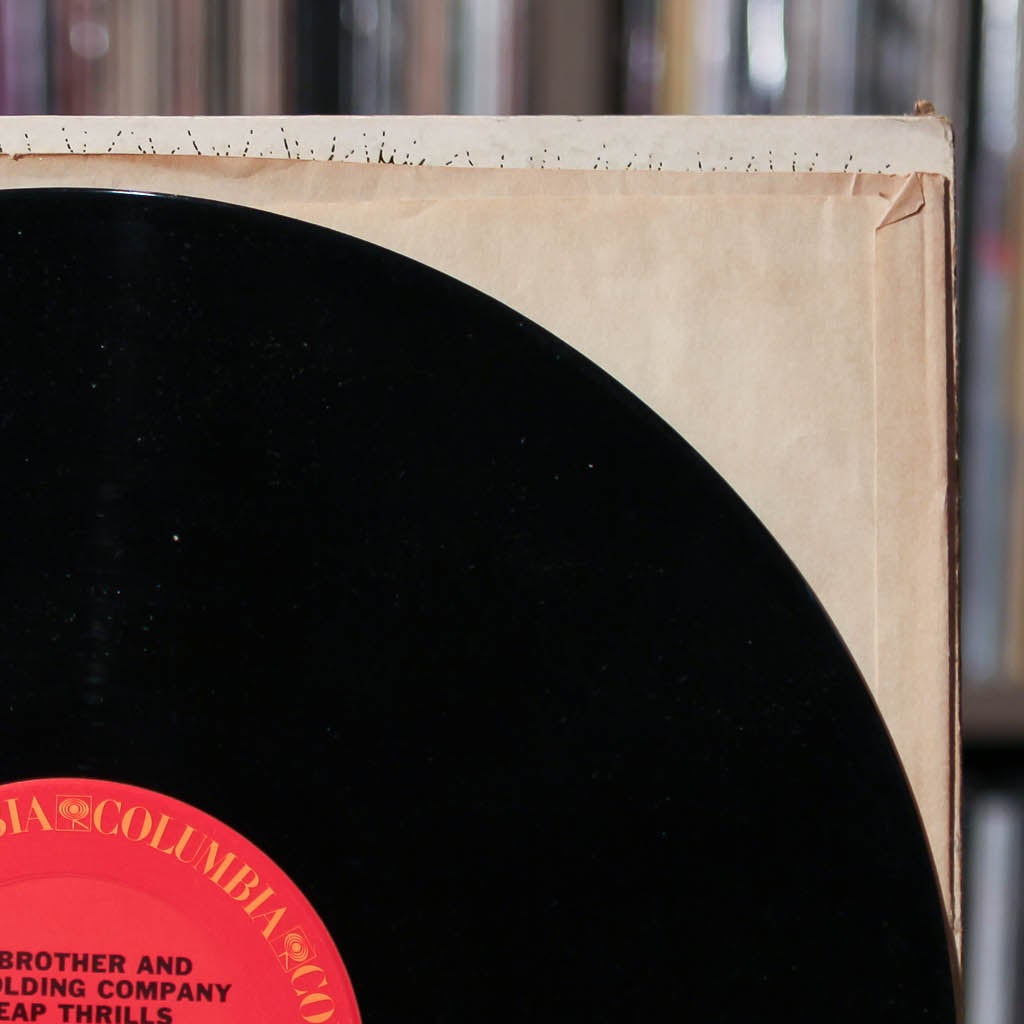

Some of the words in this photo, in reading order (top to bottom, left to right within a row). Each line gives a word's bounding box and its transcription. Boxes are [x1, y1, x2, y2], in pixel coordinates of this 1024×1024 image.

[93, 799, 287, 940] COLUMBIA
[136, 955, 193, 977] AND
[97, 979, 232, 1003] COMPANY
